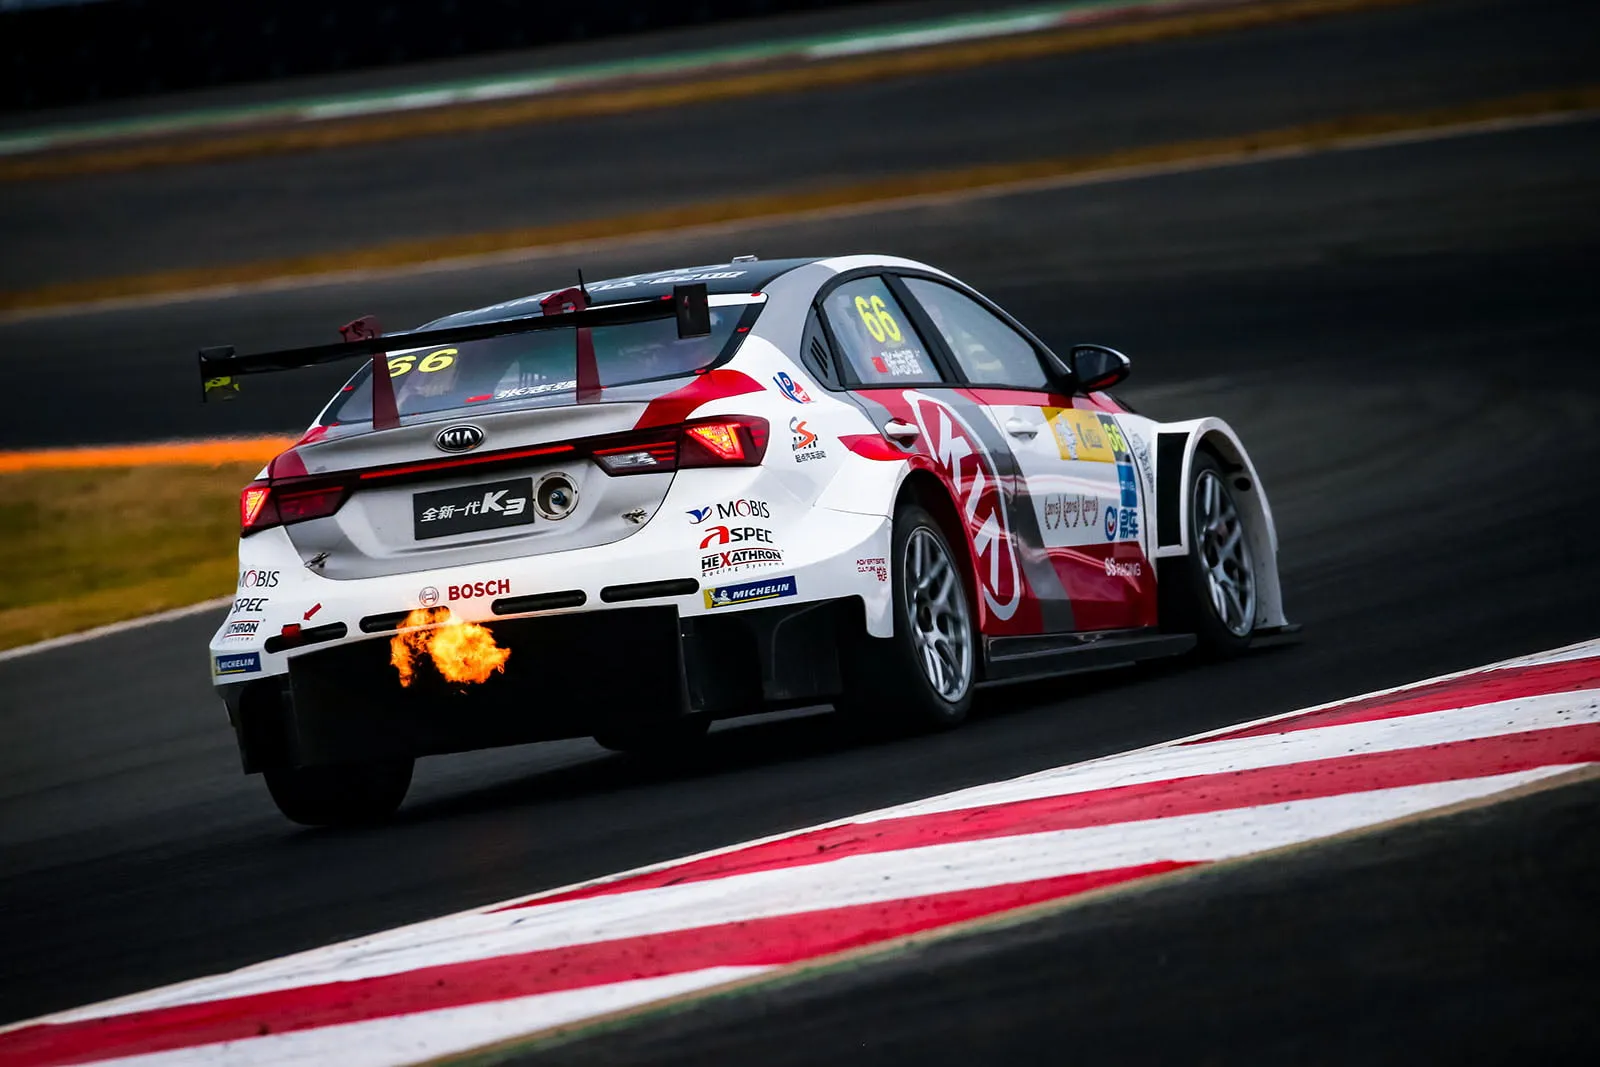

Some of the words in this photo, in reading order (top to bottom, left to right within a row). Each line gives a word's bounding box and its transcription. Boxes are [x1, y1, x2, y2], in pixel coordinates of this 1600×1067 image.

[855, 295, 901, 342] 66
[387, 348, 458, 377] 66
[444, 430, 475, 446] KIA
[1103, 423, 1126, 452] 66
[716, 499, 770, 519] MOBIS
[701, 550, 782, 570] HEXATHRON
[448, 579, 511, 601] BOSCH
[732, 583, 790, 600] MICHELIN
[228, 622, 259, 633] THRON
